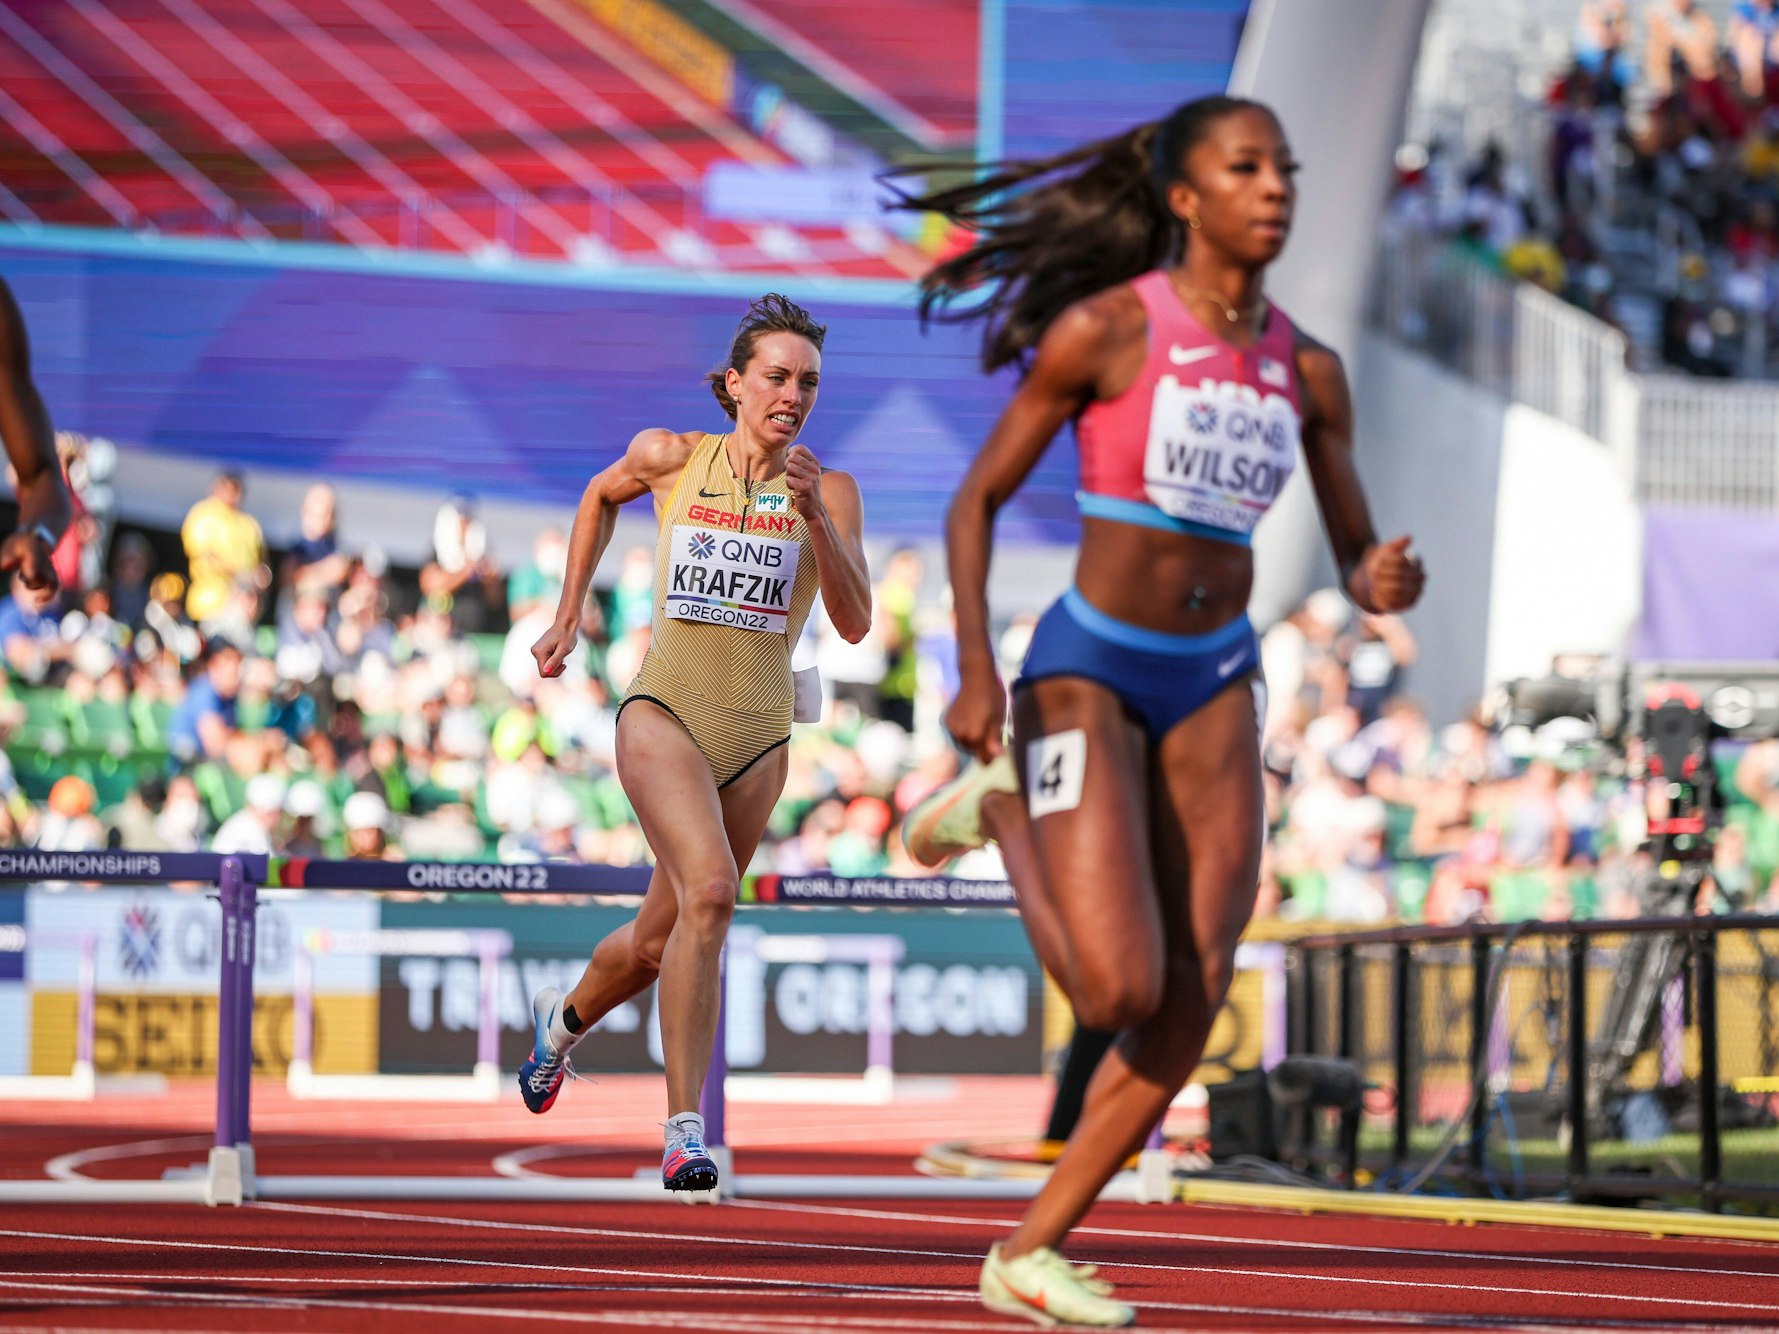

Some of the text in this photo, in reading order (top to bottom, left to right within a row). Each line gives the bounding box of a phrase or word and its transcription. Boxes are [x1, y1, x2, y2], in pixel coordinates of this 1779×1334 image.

[1225, 410, 1287, 453] QNB
[687, 504, 797, 534] GERMANY
[721, 539, 783, 568] QNB
[673, 564, 788, 607] KRAFZIK
[678, 603, 769, 629] OREGON22
[1039, 751, 1063, 798] 4
[0, 855, 161, 875] CHAMPIONSHIPS
[783, 877, 849, 898] WORLD
[851, 878, 946, 900] ATHLETICS
[175, 906, 291, 974] QB
